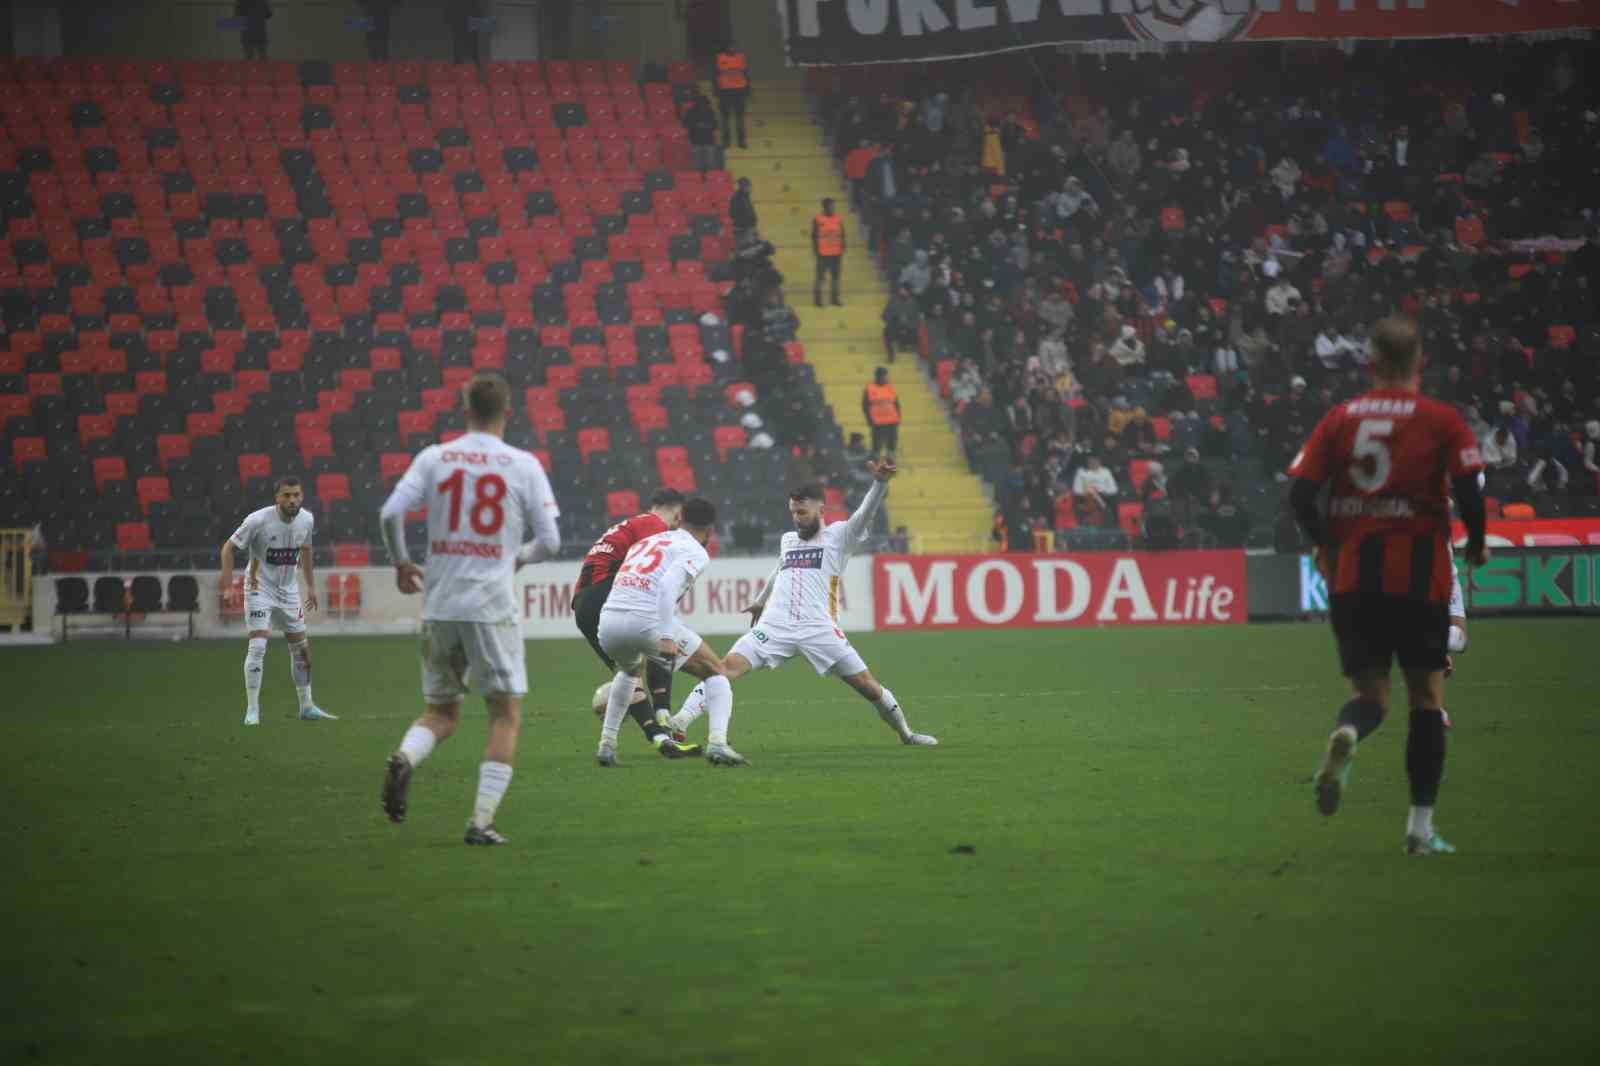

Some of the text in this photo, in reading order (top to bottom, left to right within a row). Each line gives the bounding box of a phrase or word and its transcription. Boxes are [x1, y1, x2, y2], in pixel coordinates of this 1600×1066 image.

[1349, 419, 1395, 493] 5
[437, 468, 507, 536] 18
[620, 539, 673, 575] 25
[884, 558, 1158, 625] MODA
[1164, 576, 1234, 620] Life
